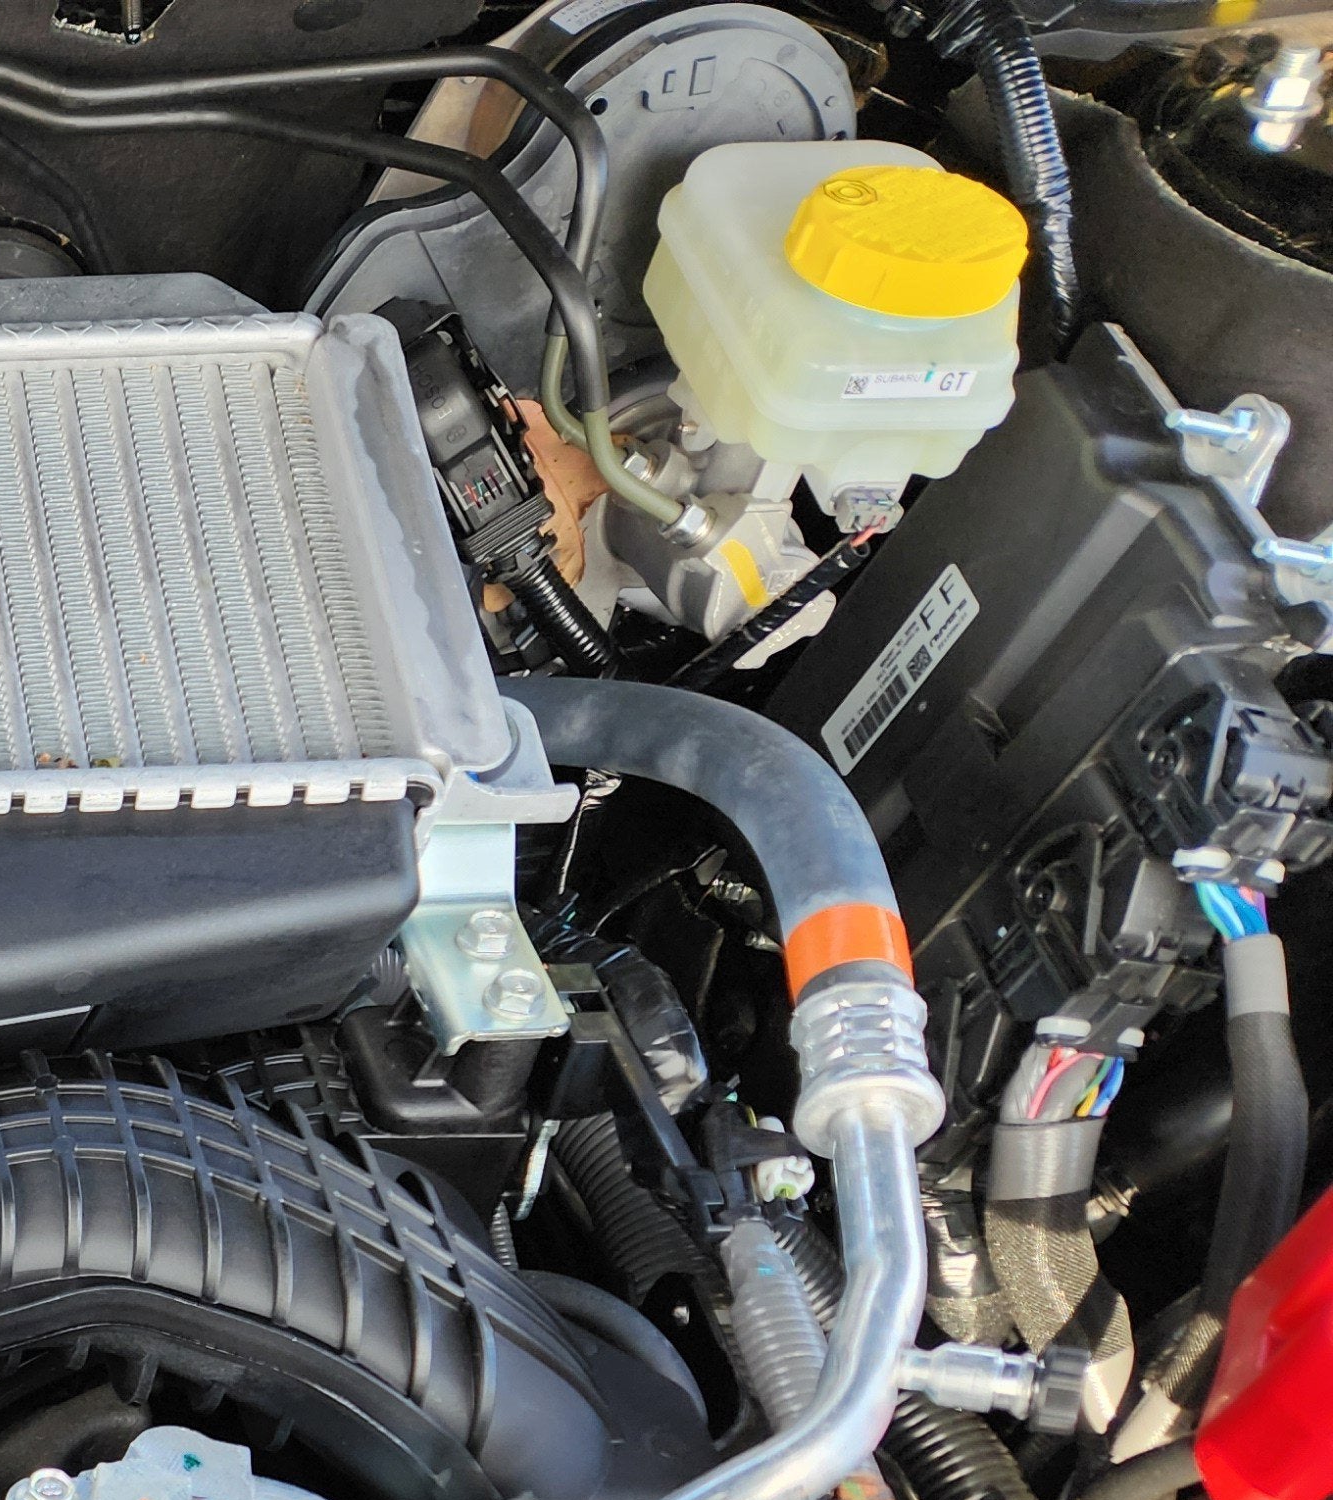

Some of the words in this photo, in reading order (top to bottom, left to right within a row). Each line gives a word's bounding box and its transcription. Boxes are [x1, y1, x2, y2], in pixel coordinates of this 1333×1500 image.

[410, 363, 452, 420] BOSCH
[874, 374, 922, 384] SUBARU
[939, 371, 970, 392] GT
